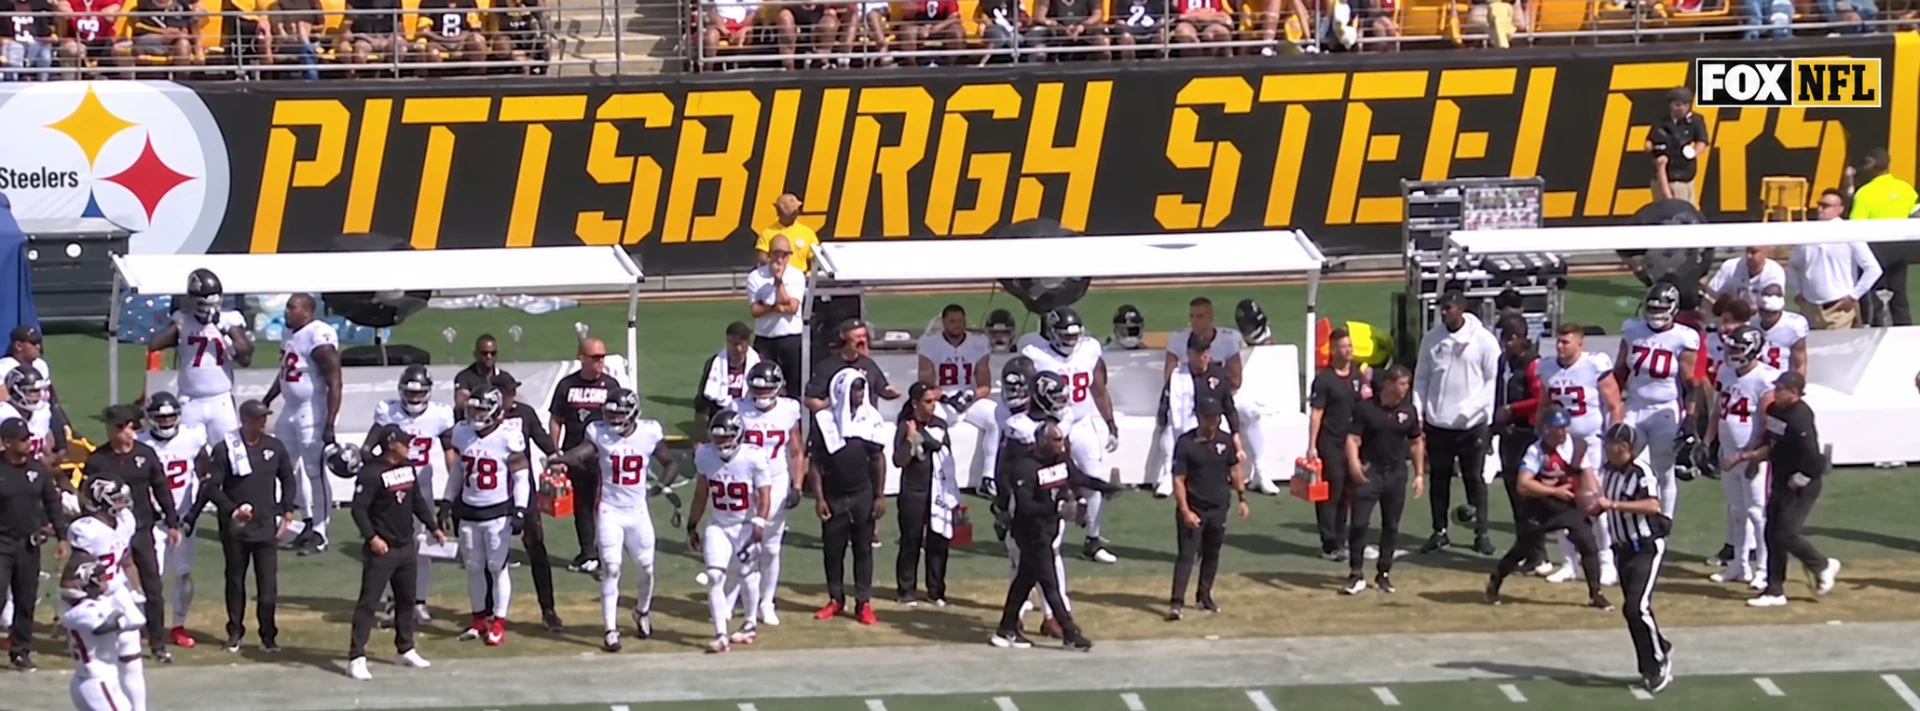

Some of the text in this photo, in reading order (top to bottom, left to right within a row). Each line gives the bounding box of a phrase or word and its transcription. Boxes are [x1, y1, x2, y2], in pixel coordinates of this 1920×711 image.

[249, 80, 1114, 254] PITTSBURGH
[188, 336, 224, 367] 71
[1632, 346, 1672, 379] 70
[939, 363, 972, 386] 81
[1060, 372, 1090, 403] 8
[466, 449, 492, 457] ATL
[461, 456, 498, 489] 78
[610, 455, 643, 485] 19
[709, 480, 749, 511] 29
